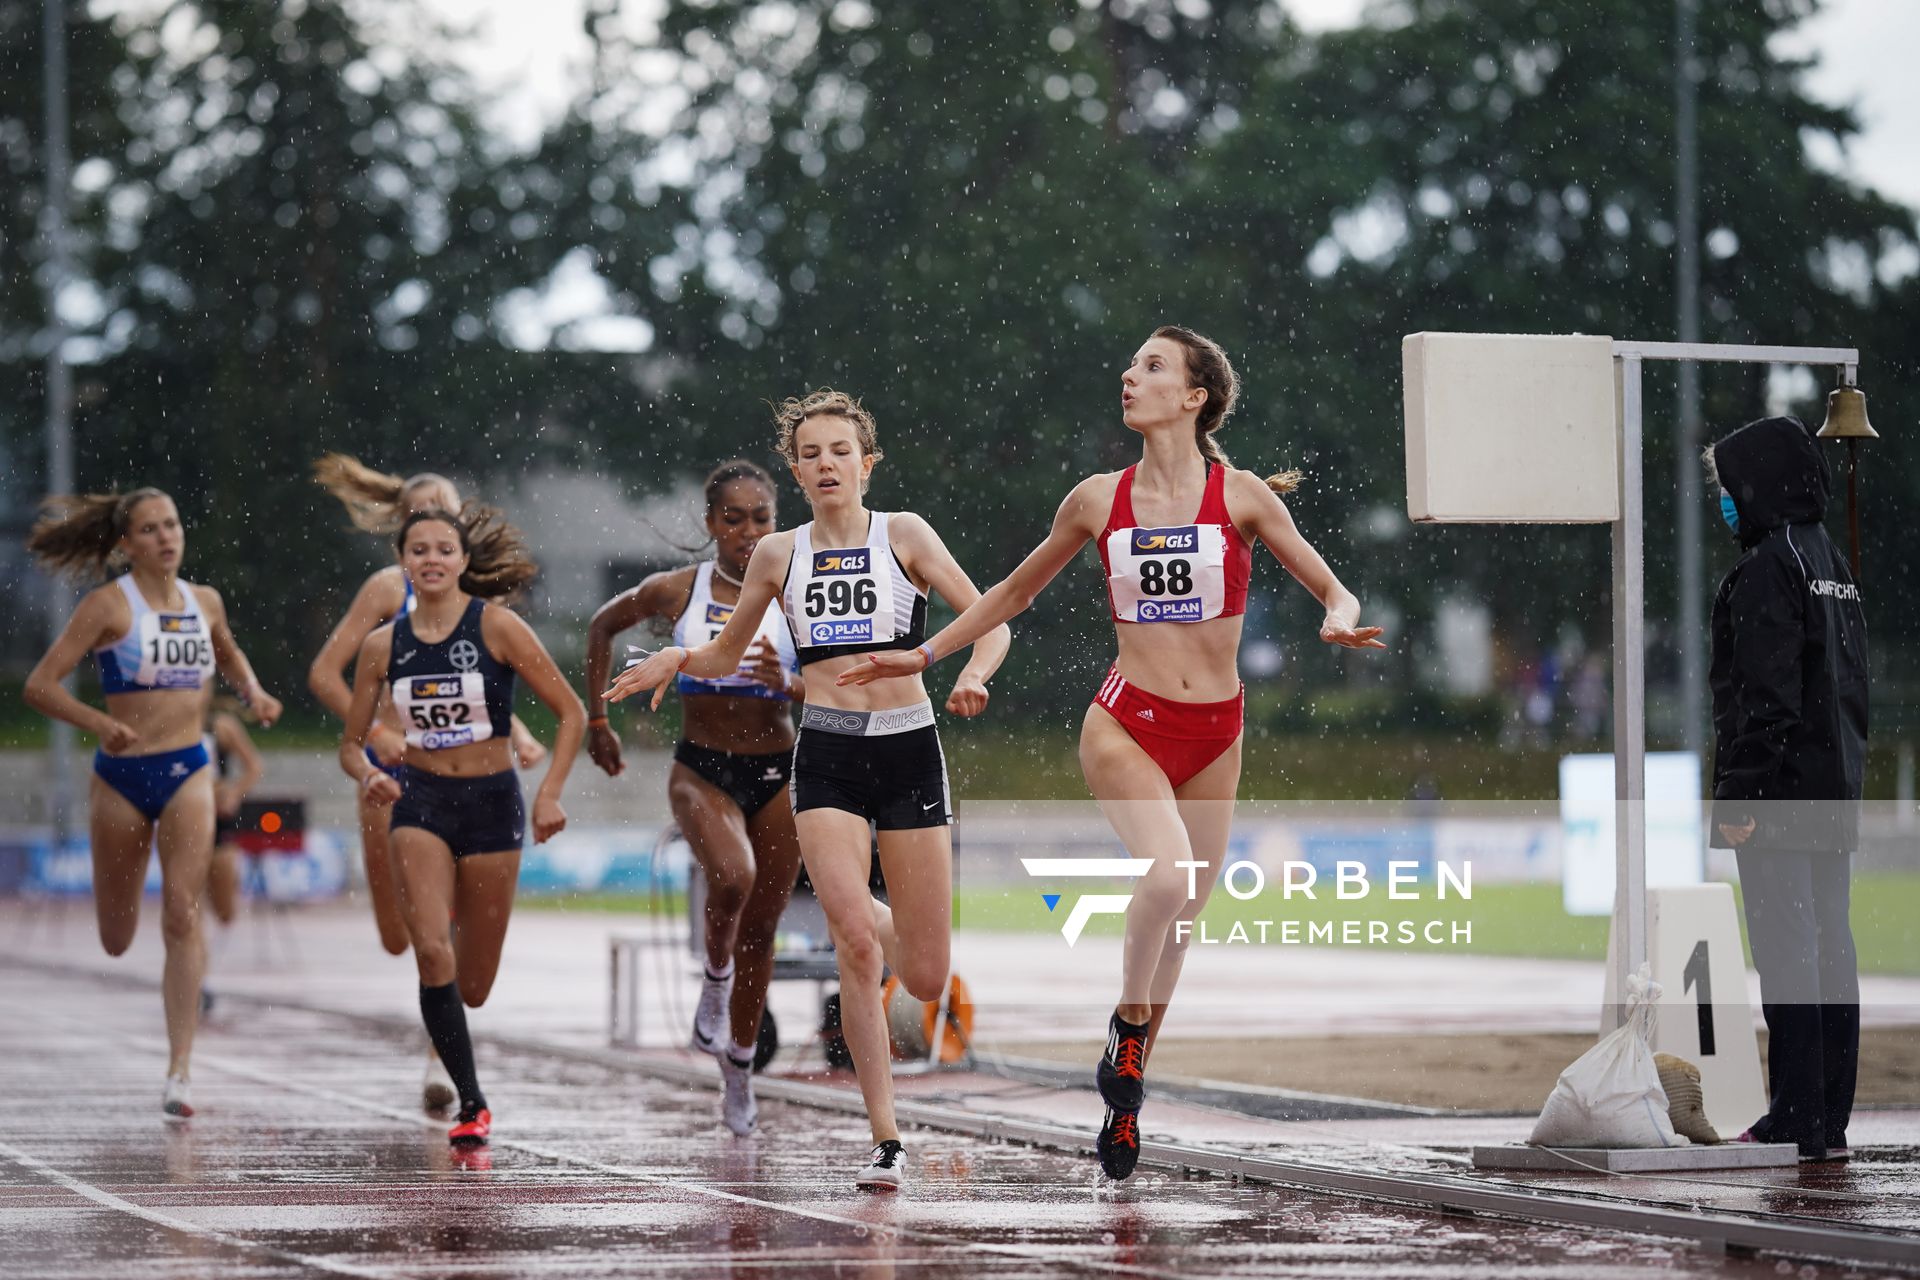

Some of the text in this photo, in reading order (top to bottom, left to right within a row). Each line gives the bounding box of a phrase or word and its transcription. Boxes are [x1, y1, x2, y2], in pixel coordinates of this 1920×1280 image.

[1166, 533, 1193, 549] GLS
[841, 555, 866, 570] GLS
[1139, 558, 1194, 596] 88
[805, 578, 878, 618] 596
[1162, 602, 1200, 614] PLAN
[835, 623, 870, 635] PLAN
[149, 638, 210, 666] 1005
[437, 681, 460, 696] GLS
[409, 702, 473, 730] 562
[806, 709, 863, 730] PRO
[874, 706, 932, 730] NIKE
[1683, 940, 1716, 1056] 1
